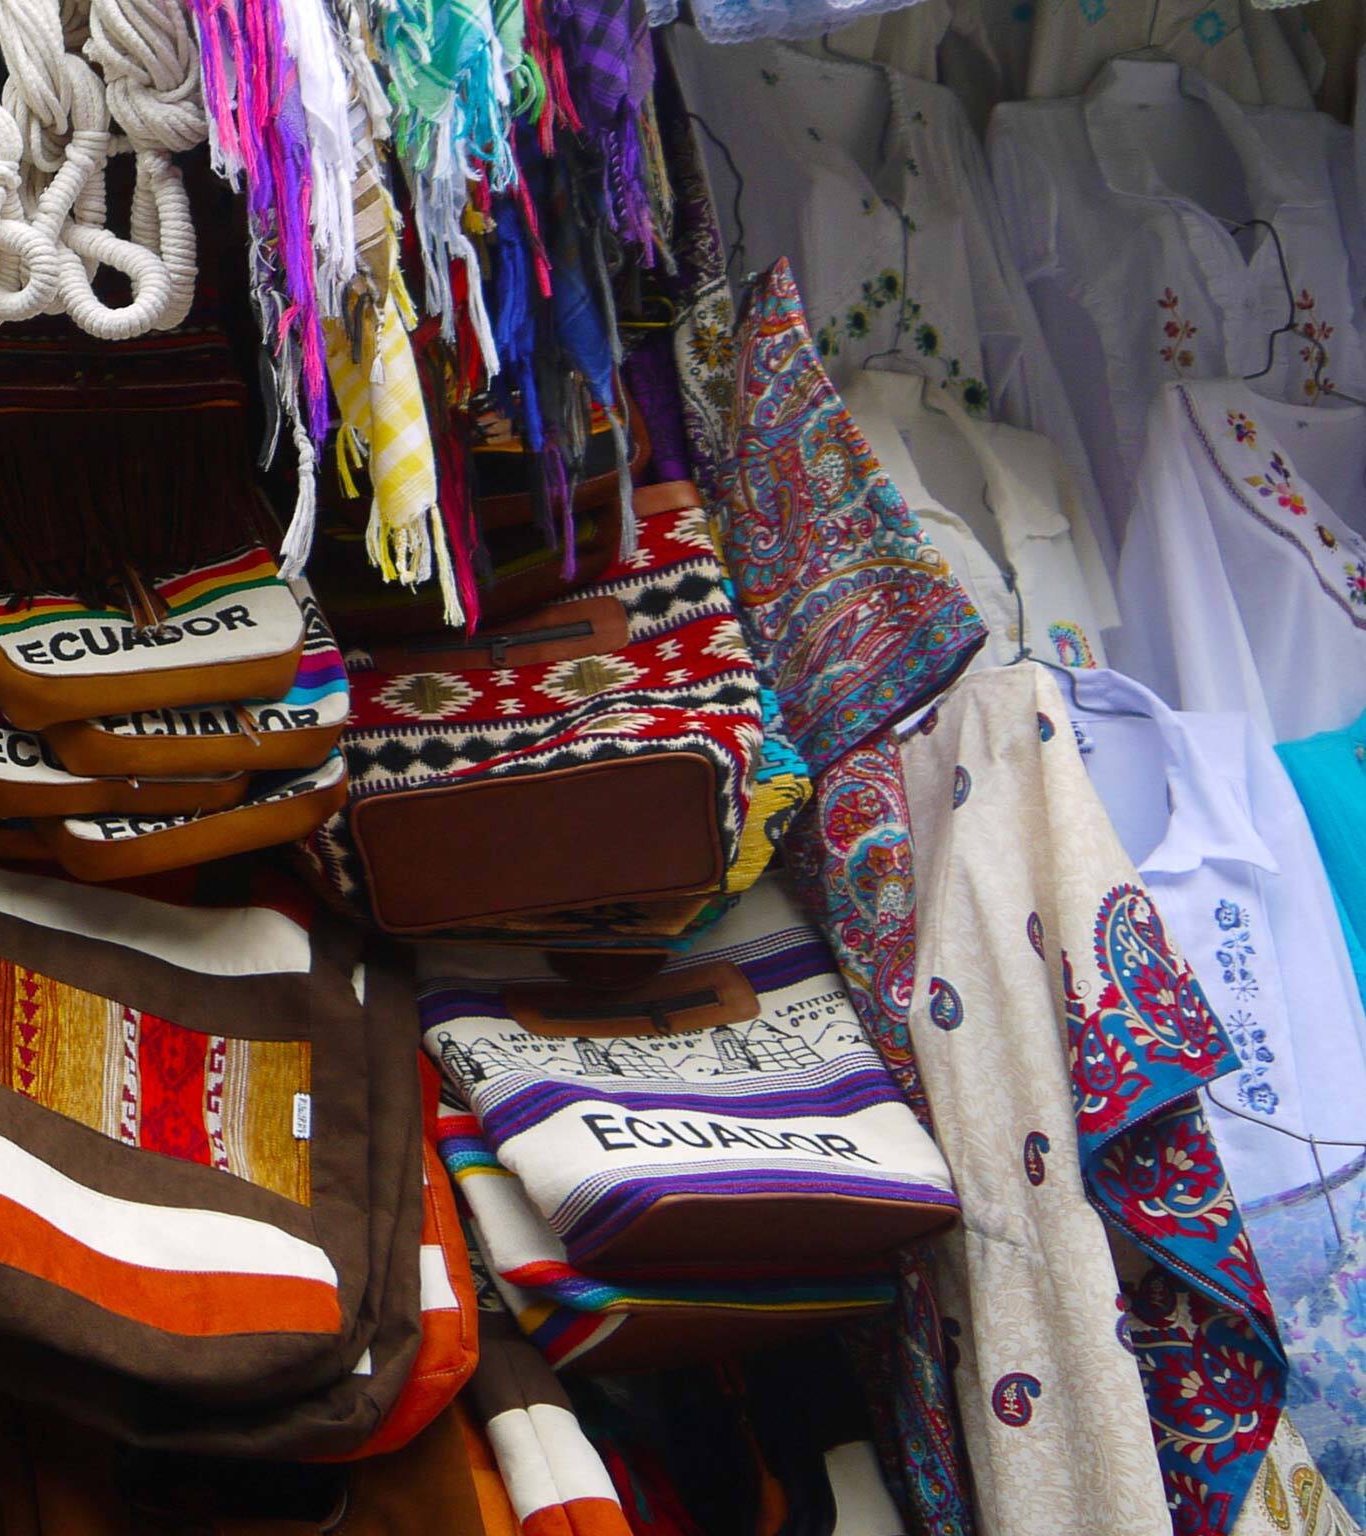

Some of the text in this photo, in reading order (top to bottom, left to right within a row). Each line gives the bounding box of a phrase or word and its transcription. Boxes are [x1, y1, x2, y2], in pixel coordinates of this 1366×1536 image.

[15, 604, 258, 665] ECUADOR
[774, 991, 845, 1017] LATITUD
[581, 1113, 882, 1165] ECUADOR
